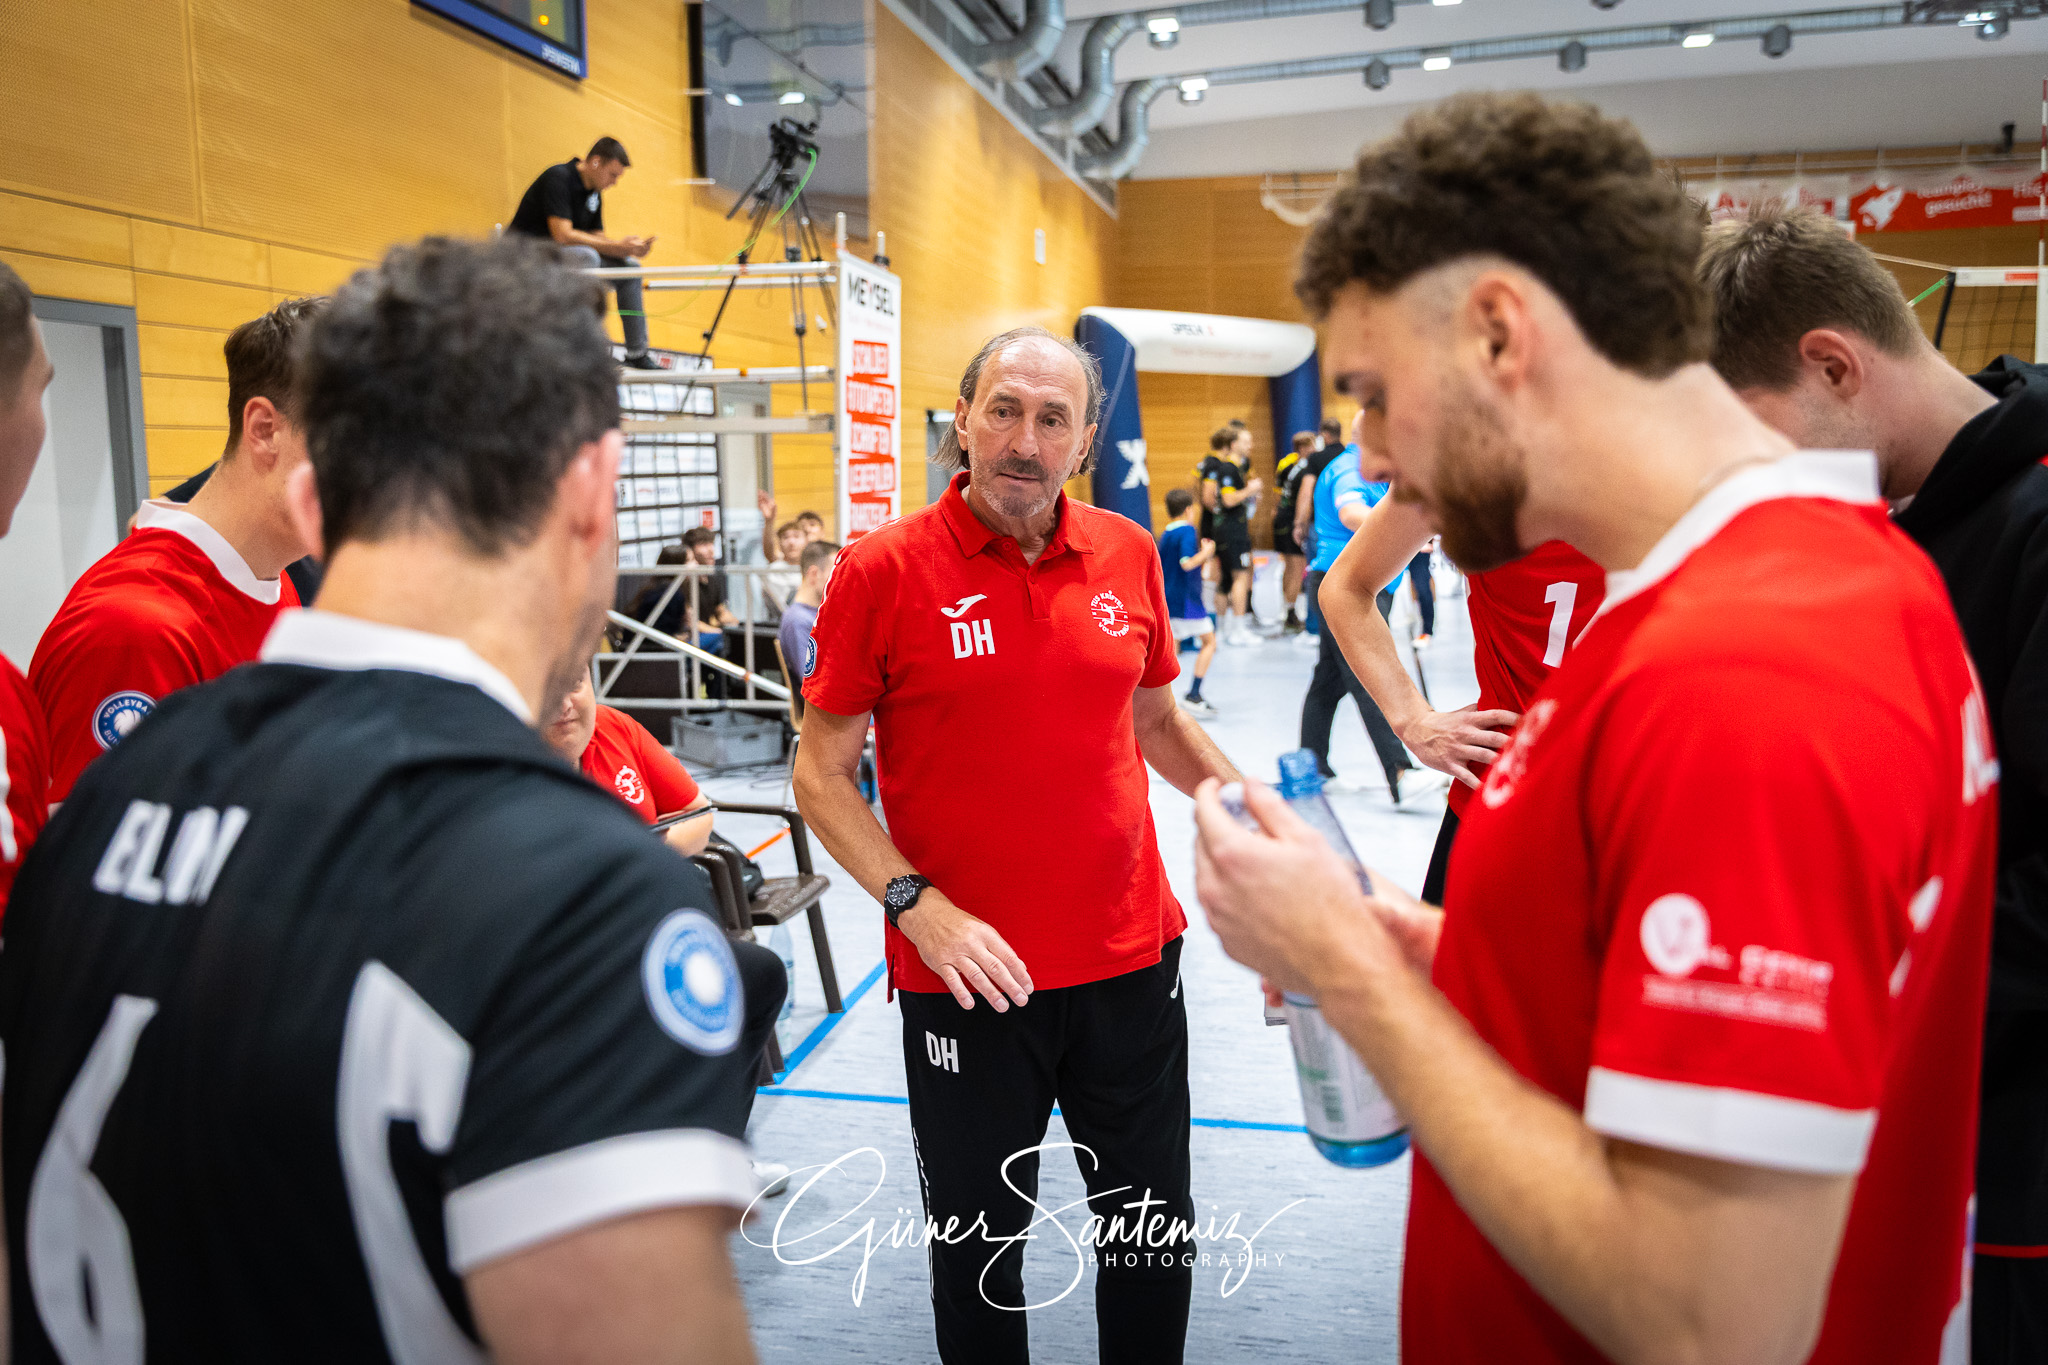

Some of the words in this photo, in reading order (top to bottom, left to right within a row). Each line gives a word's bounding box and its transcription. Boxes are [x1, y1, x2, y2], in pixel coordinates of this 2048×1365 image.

[847, 272, 895, 317] MEYSEL
[950, 619, 996, 660] DH
[925, 1030, 960, 1073] DH
